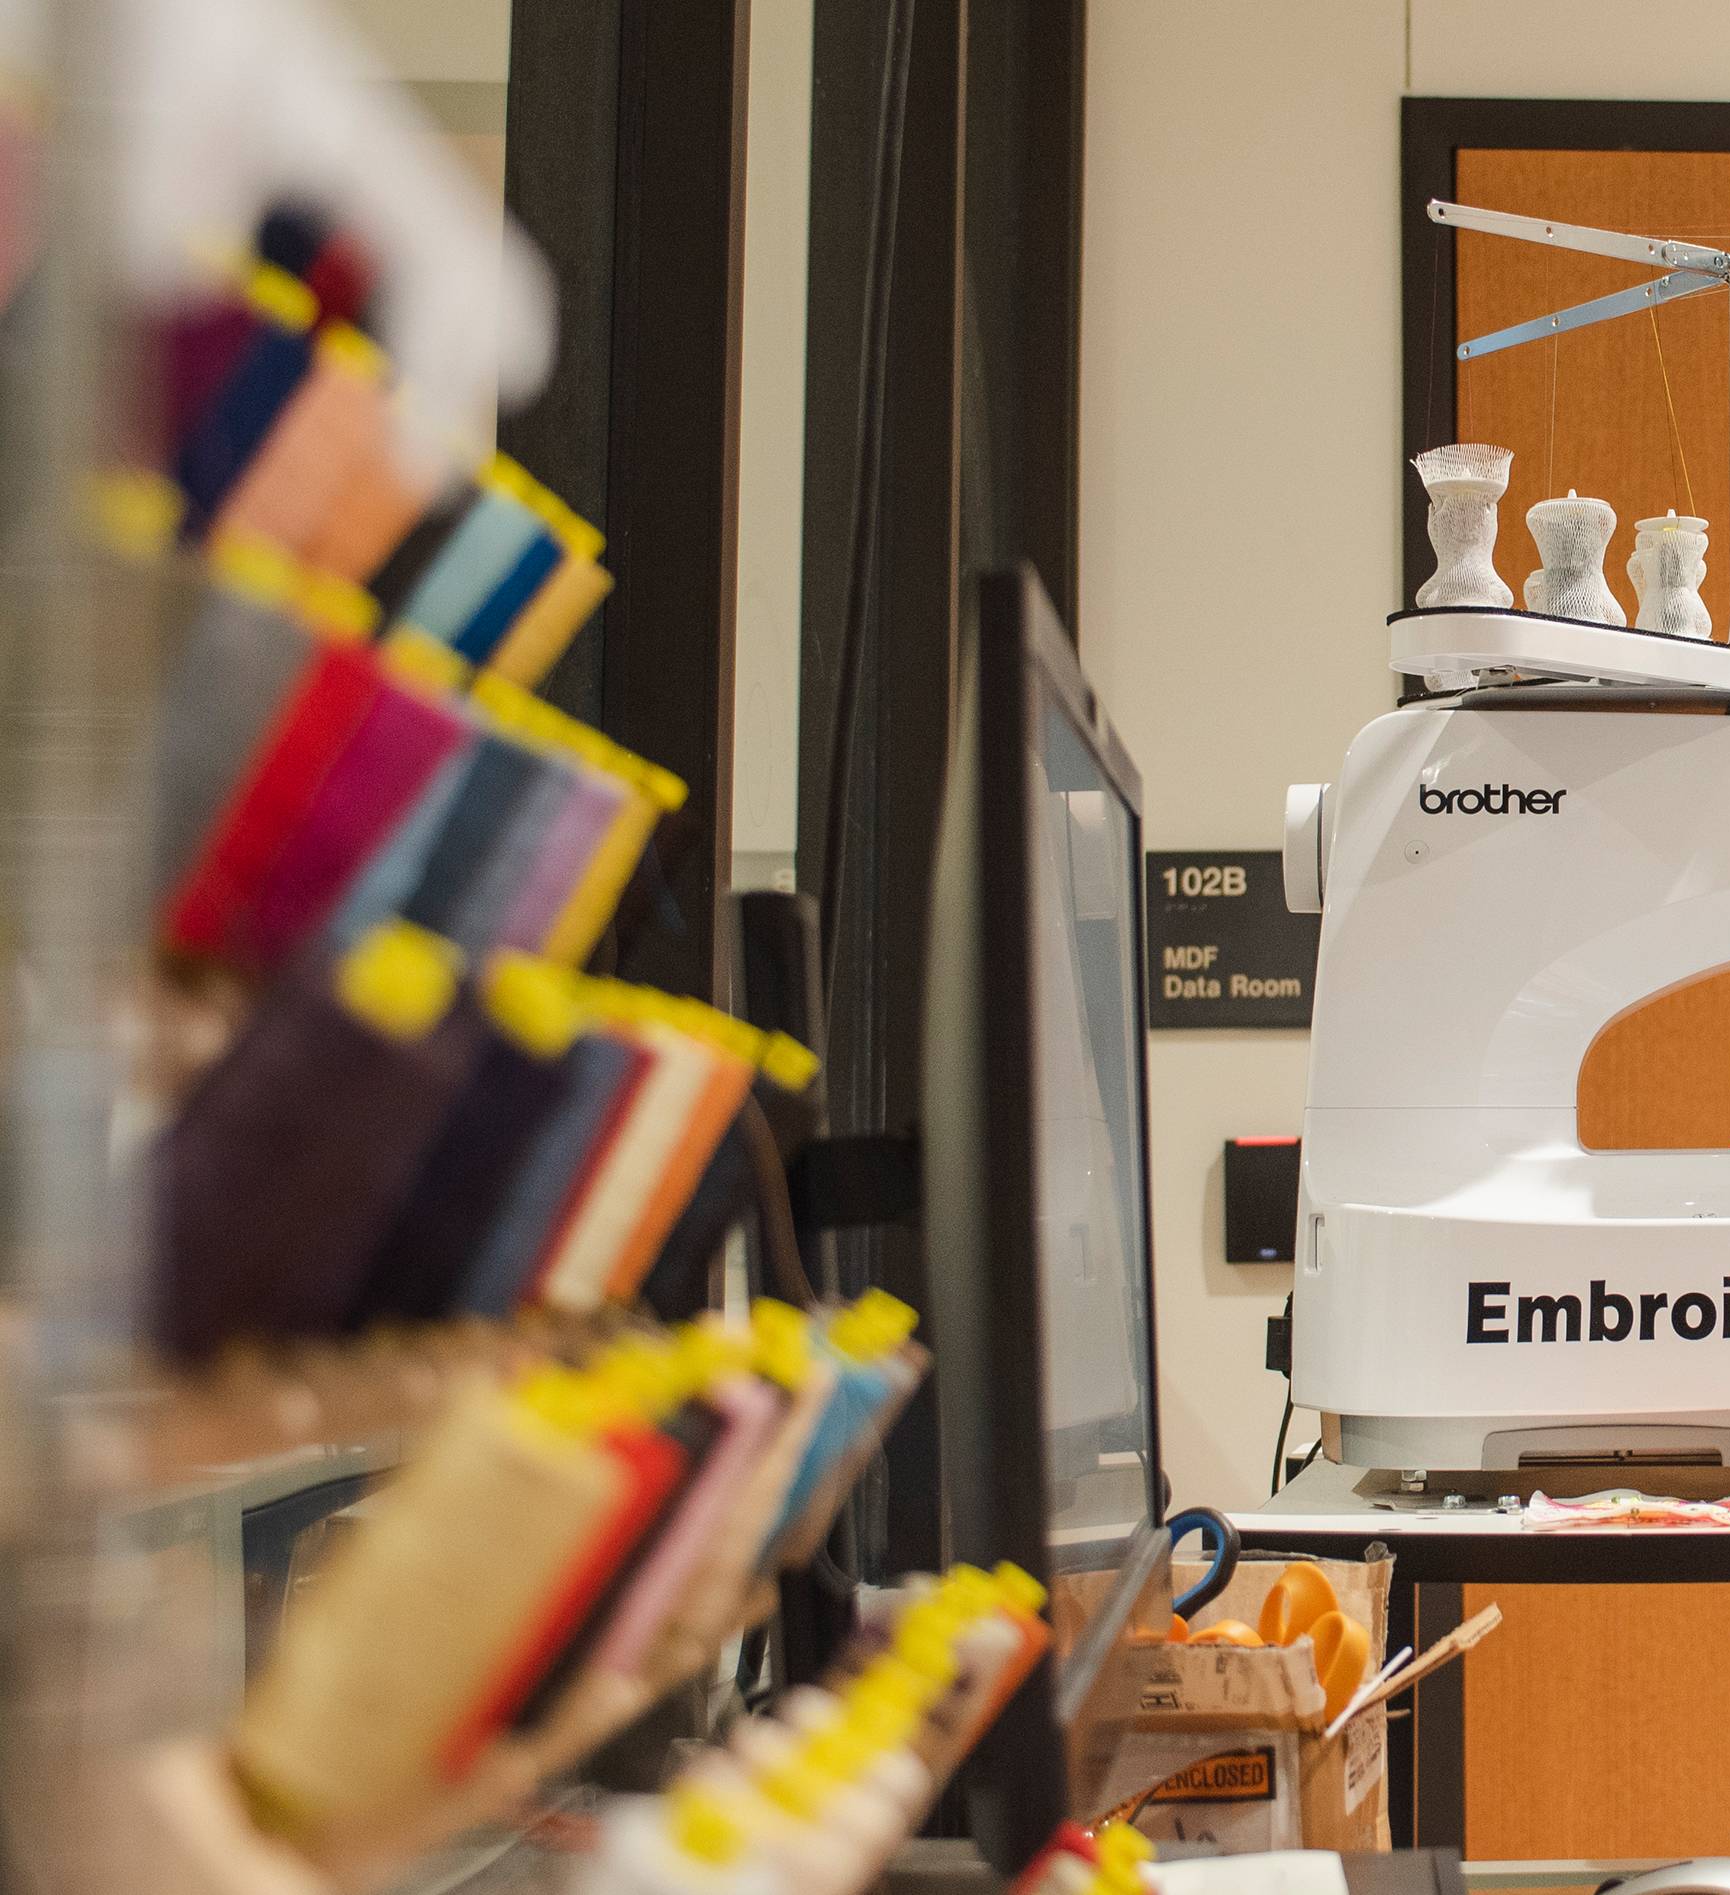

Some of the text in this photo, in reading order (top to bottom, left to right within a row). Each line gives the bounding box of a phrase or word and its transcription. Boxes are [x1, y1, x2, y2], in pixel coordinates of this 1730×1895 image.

[1420, 784, 1567, 814] brother
[1163, 867, 1247, 896] 102B
[1163, 946, 1218, 970] MDF
[1164, 973, 1301, 998] Data Room
